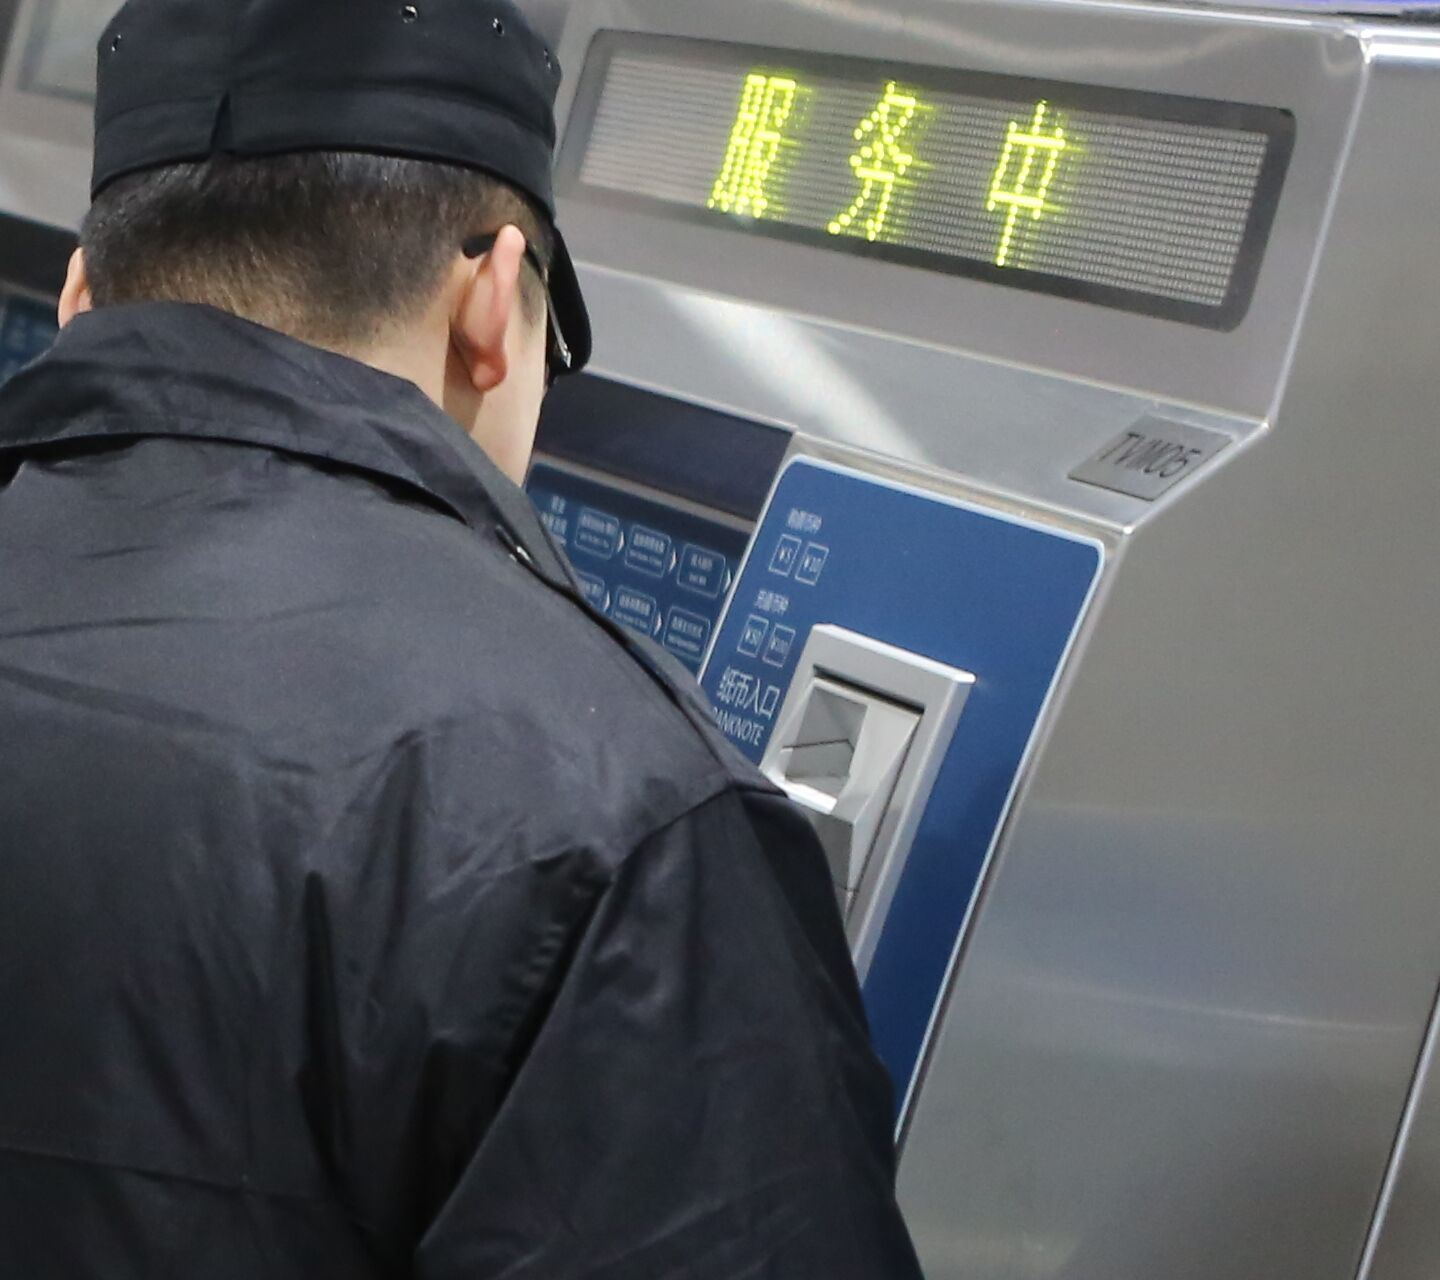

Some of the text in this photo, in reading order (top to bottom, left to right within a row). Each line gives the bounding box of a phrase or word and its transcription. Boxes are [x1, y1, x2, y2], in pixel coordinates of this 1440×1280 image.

[706, 73, 1066, 266] 服务中
[716, 664, 781, 721] 纸币入口
